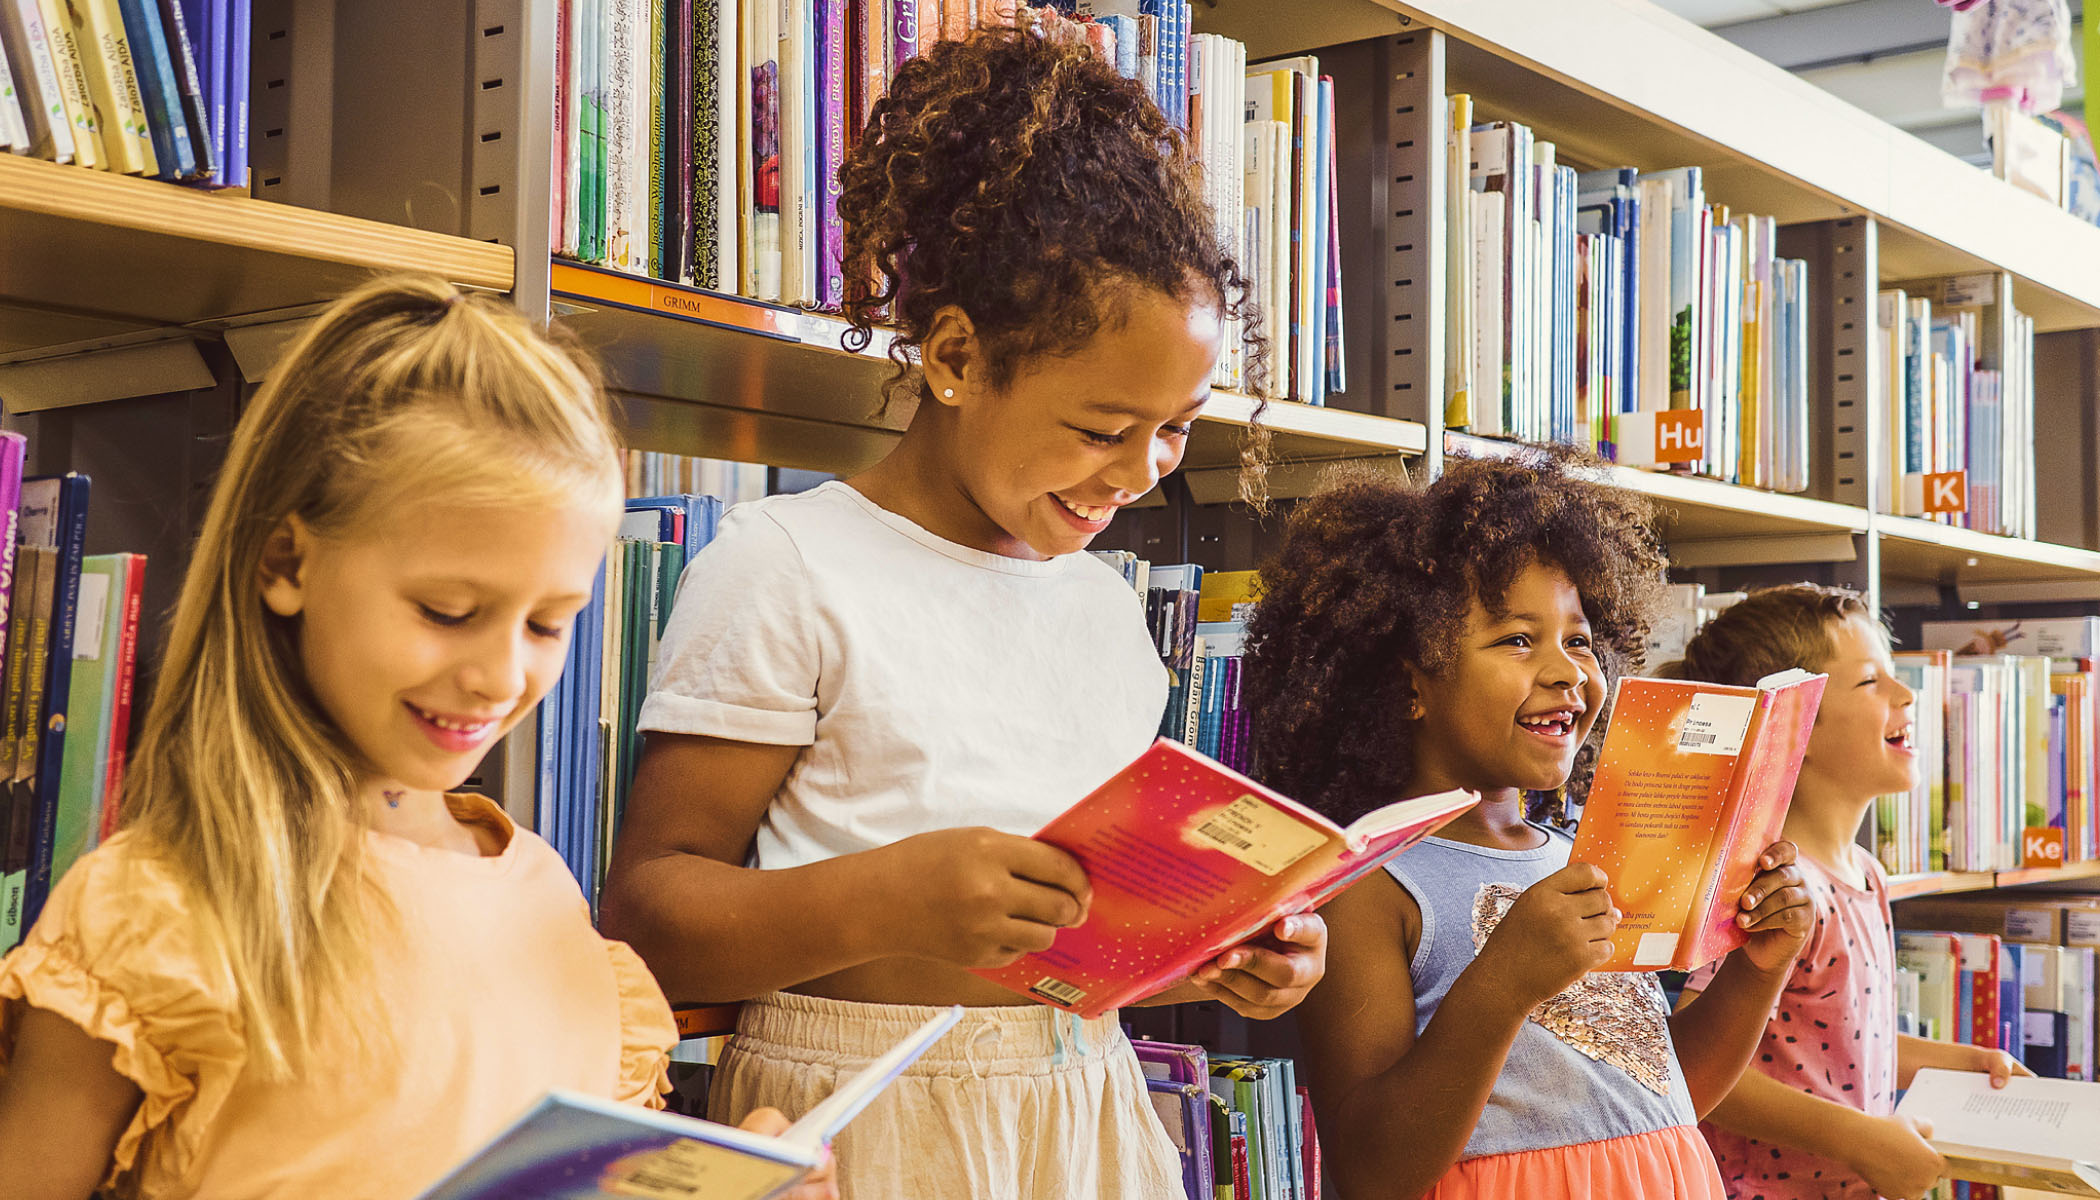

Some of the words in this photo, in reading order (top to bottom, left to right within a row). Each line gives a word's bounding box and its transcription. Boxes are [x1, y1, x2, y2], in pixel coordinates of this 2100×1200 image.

[52, 26, 65, 55] AJDA
[64, 31, 77, 60] AJDA
[102, 33, 117, 61] AJDA
[116, 37, 131, 66] AJDA
[831, 24, 842, 102] PRAVLJICE
[73, 63, 90, 108] Založba
[112, 64, 129, 109] Založba
[126, 69, 142, 114] Založba
[652, 104, 660, 147] Grimm
[827, 111, 842, 196] GRIMMOVE
[651, 150, 660, 200] Wilhelm
[653, 202, 659, 211] in
[651, 213, 659, 246] Jacob
[664, 295, 700, 312] GRIMM
[1660, 422, 1702, 450] Hu
[1933, 477, 1958, 507] K
[1192, 656, 1205, 705] Bogdan
[26, 703, 38, 742] govori
[1187, 710, 1198, 746] Grom
[2026, 837, 2061, 860] Ke
[7, 887, 19, 926] Gibson
